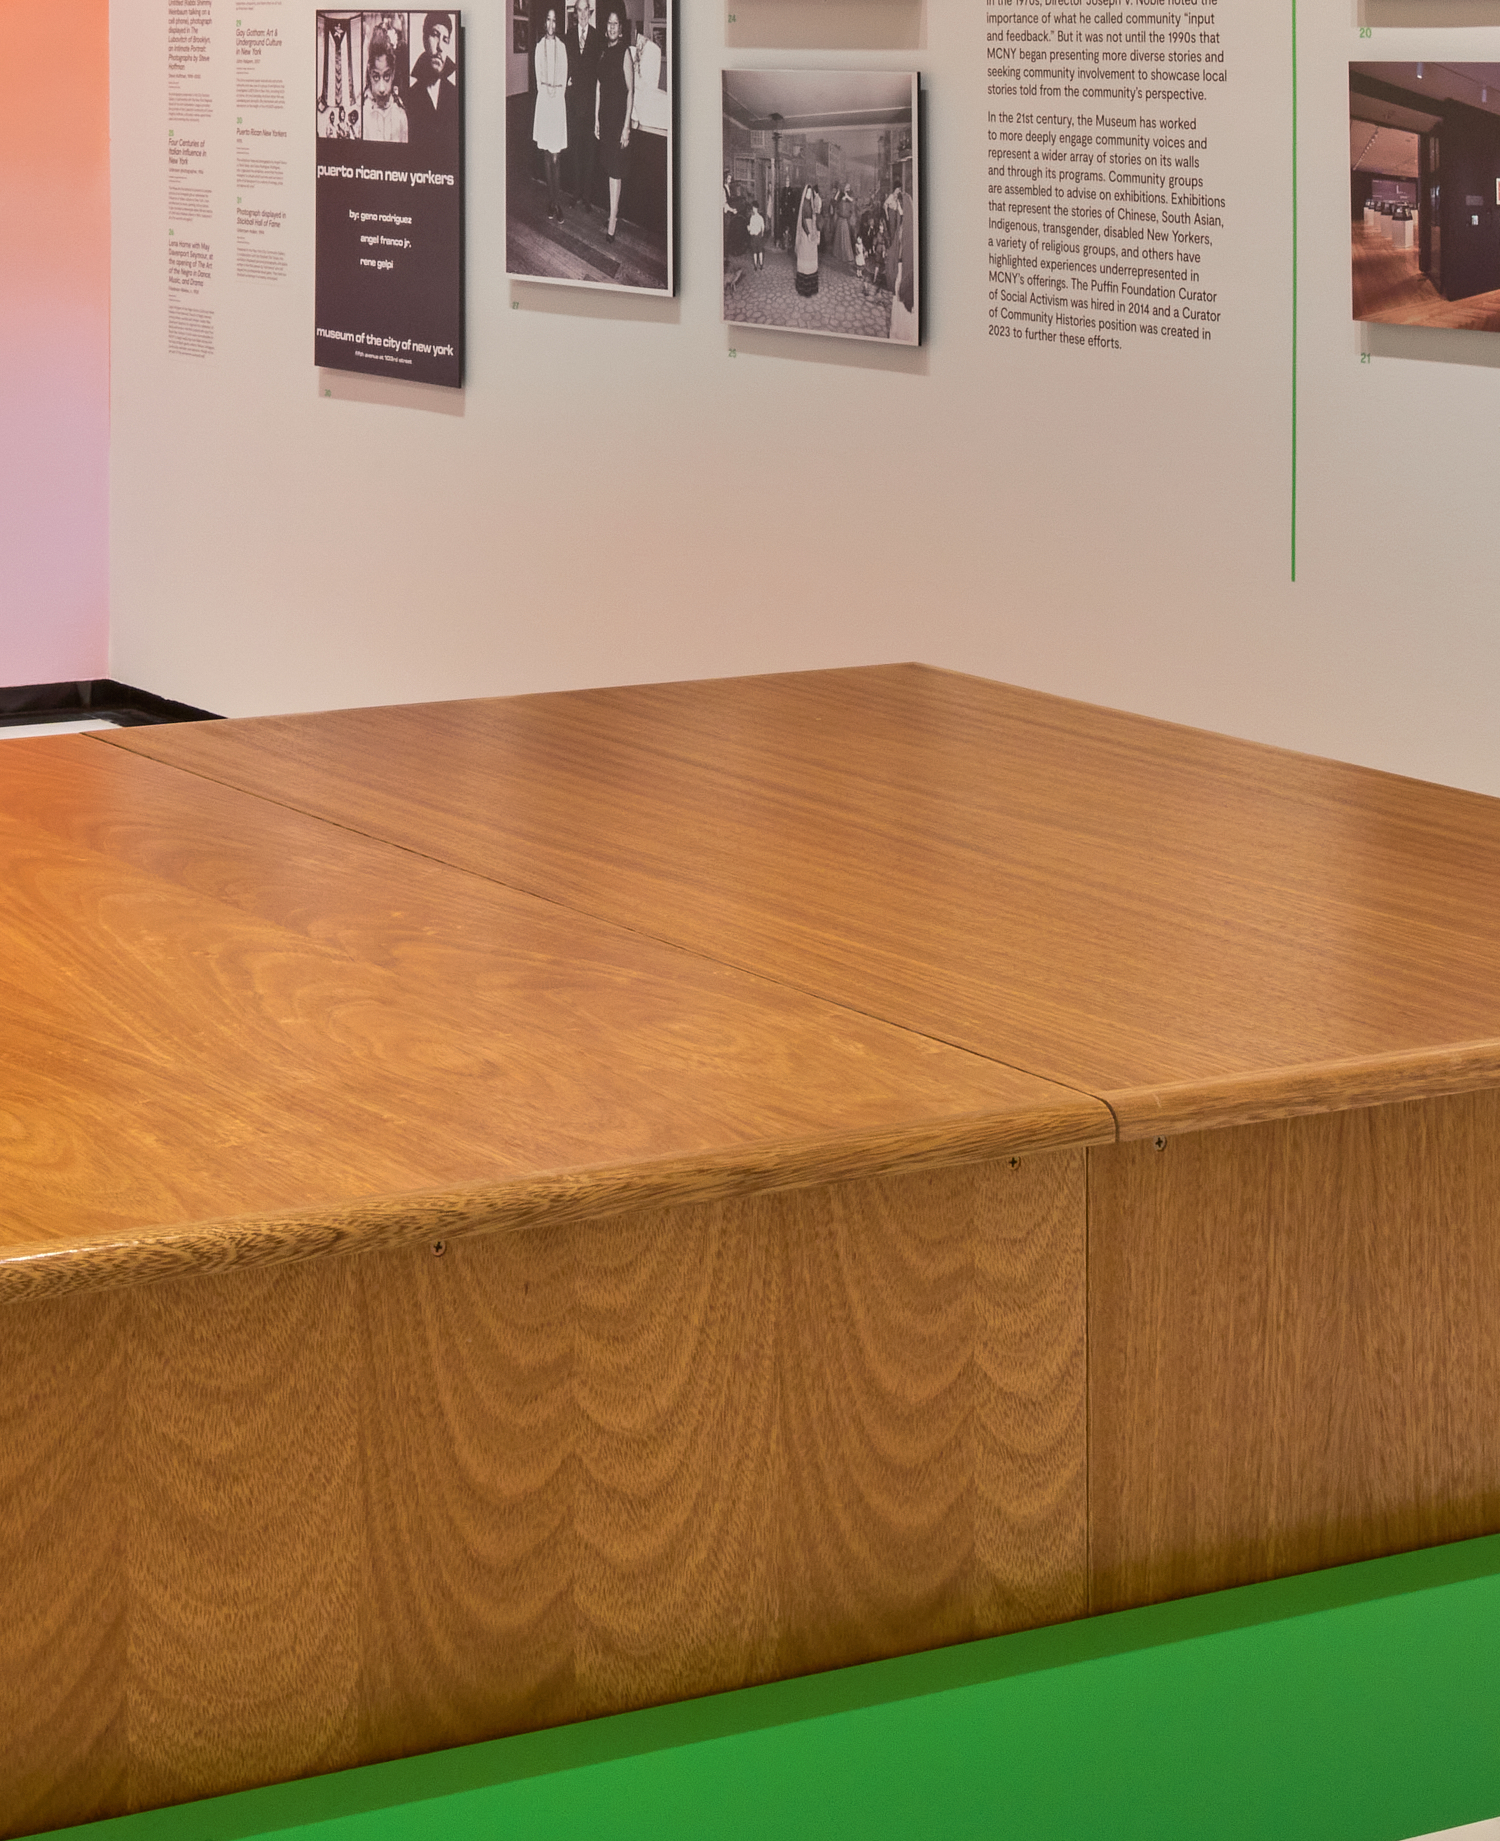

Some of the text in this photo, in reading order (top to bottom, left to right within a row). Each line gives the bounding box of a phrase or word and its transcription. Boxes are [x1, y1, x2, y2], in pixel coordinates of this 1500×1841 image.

[728, 14, 736, 23] 24
[1360, 27, 1372, 38] 20
[1361, 353, 1370, 364] 21
